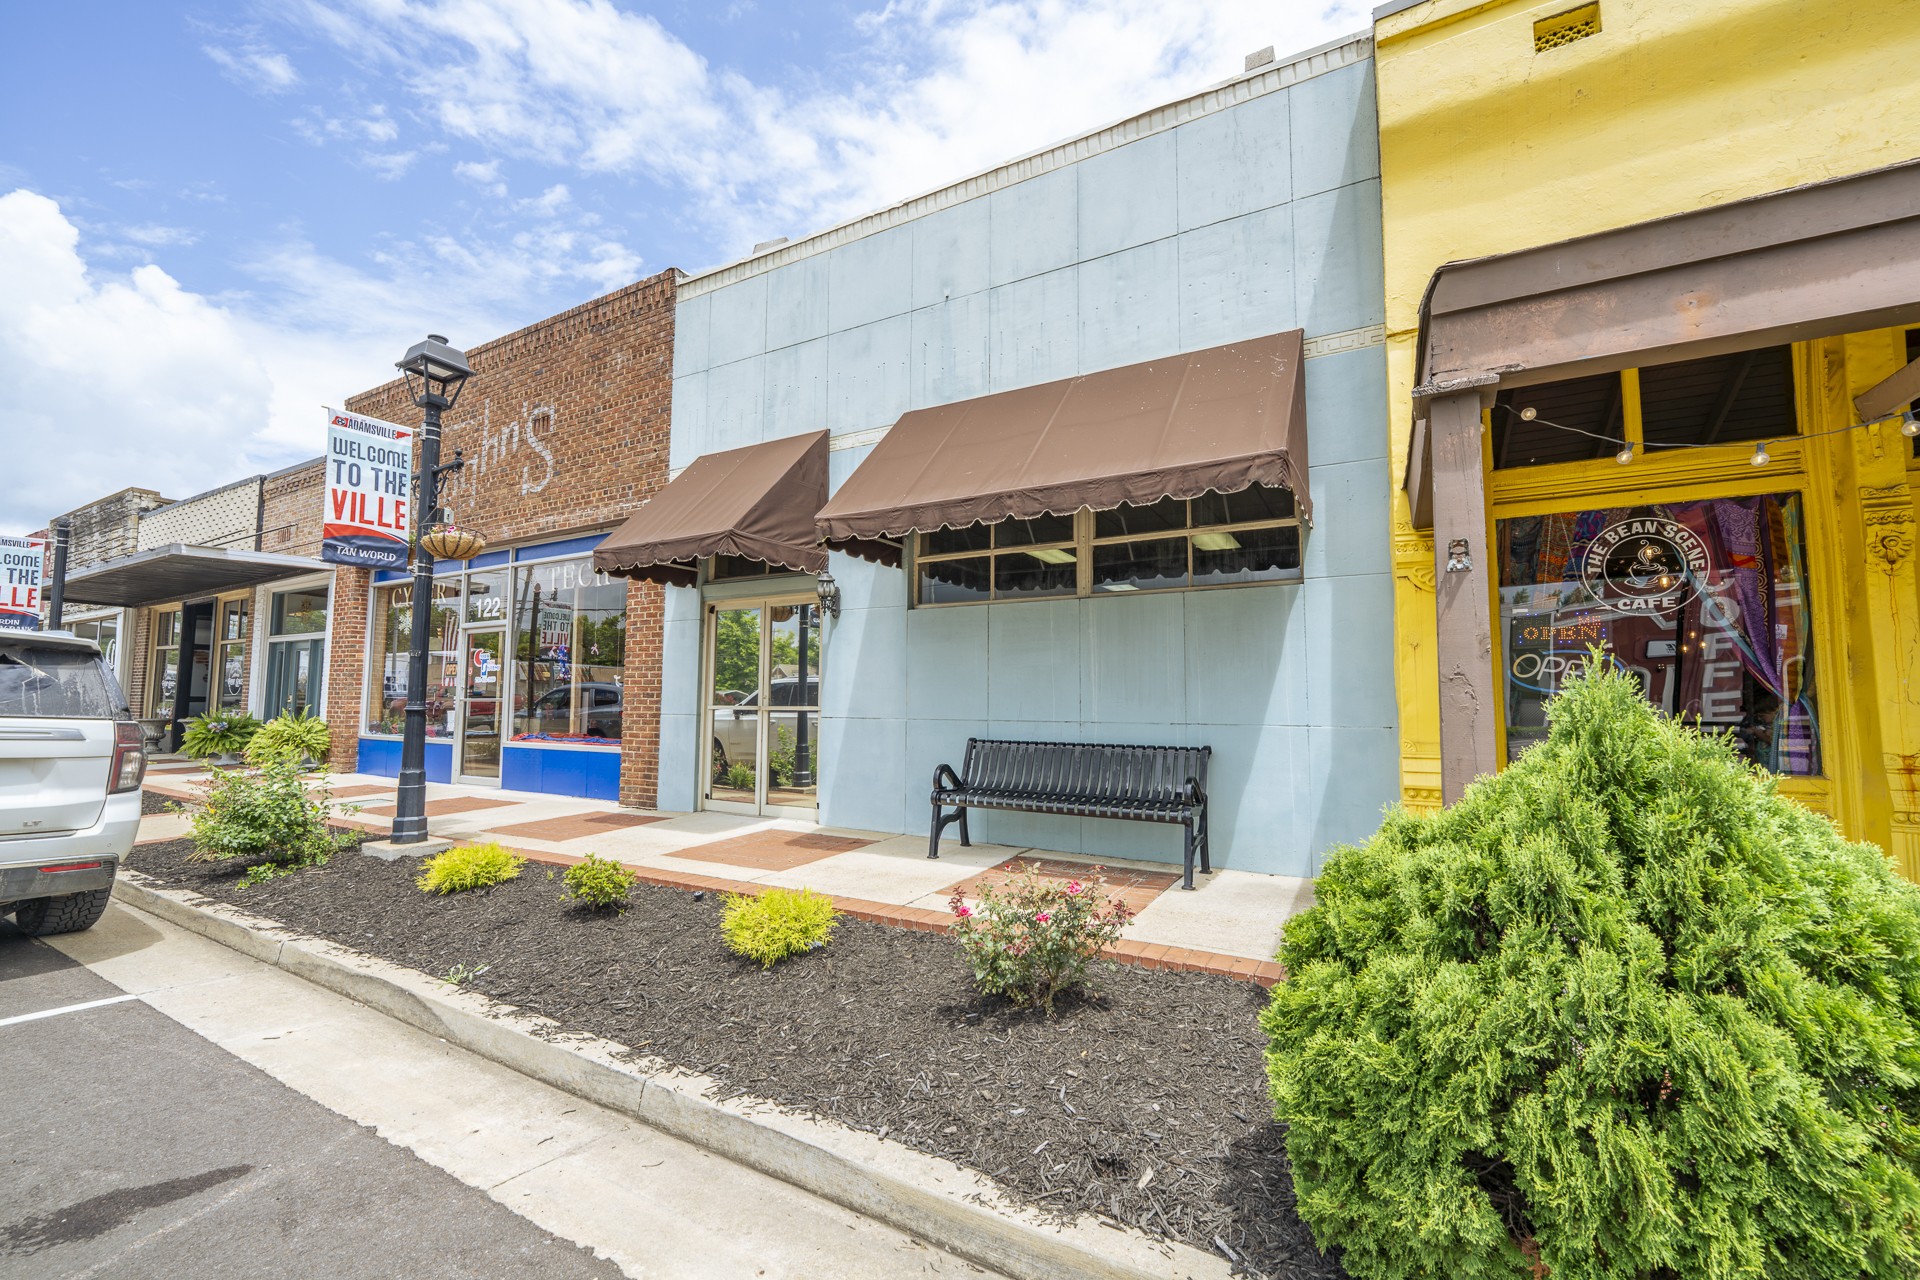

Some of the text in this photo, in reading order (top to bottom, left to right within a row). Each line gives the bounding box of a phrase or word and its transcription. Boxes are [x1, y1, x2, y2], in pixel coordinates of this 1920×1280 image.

[348, 418, 396, 440] ADAMSVILLE
[333, 437, 408, 469] WELCOME
[332, 459, 407, 497] TO THE
[331, 488, 406, 531] VILLE
[336, 545, 397, 561] TAN WORLD
[1587, 520, 1706, 574] THE BEAN SCENE
[7, 568, 39, 586] THE
[391, 582, 447, 608] CYR
[1617, 596, 1677, 610] CAFE
[476, 597, 501, 618] 122
[1523, 625, 1600, 640] OPEN
[1512, 653, 1588, 682] OPE
